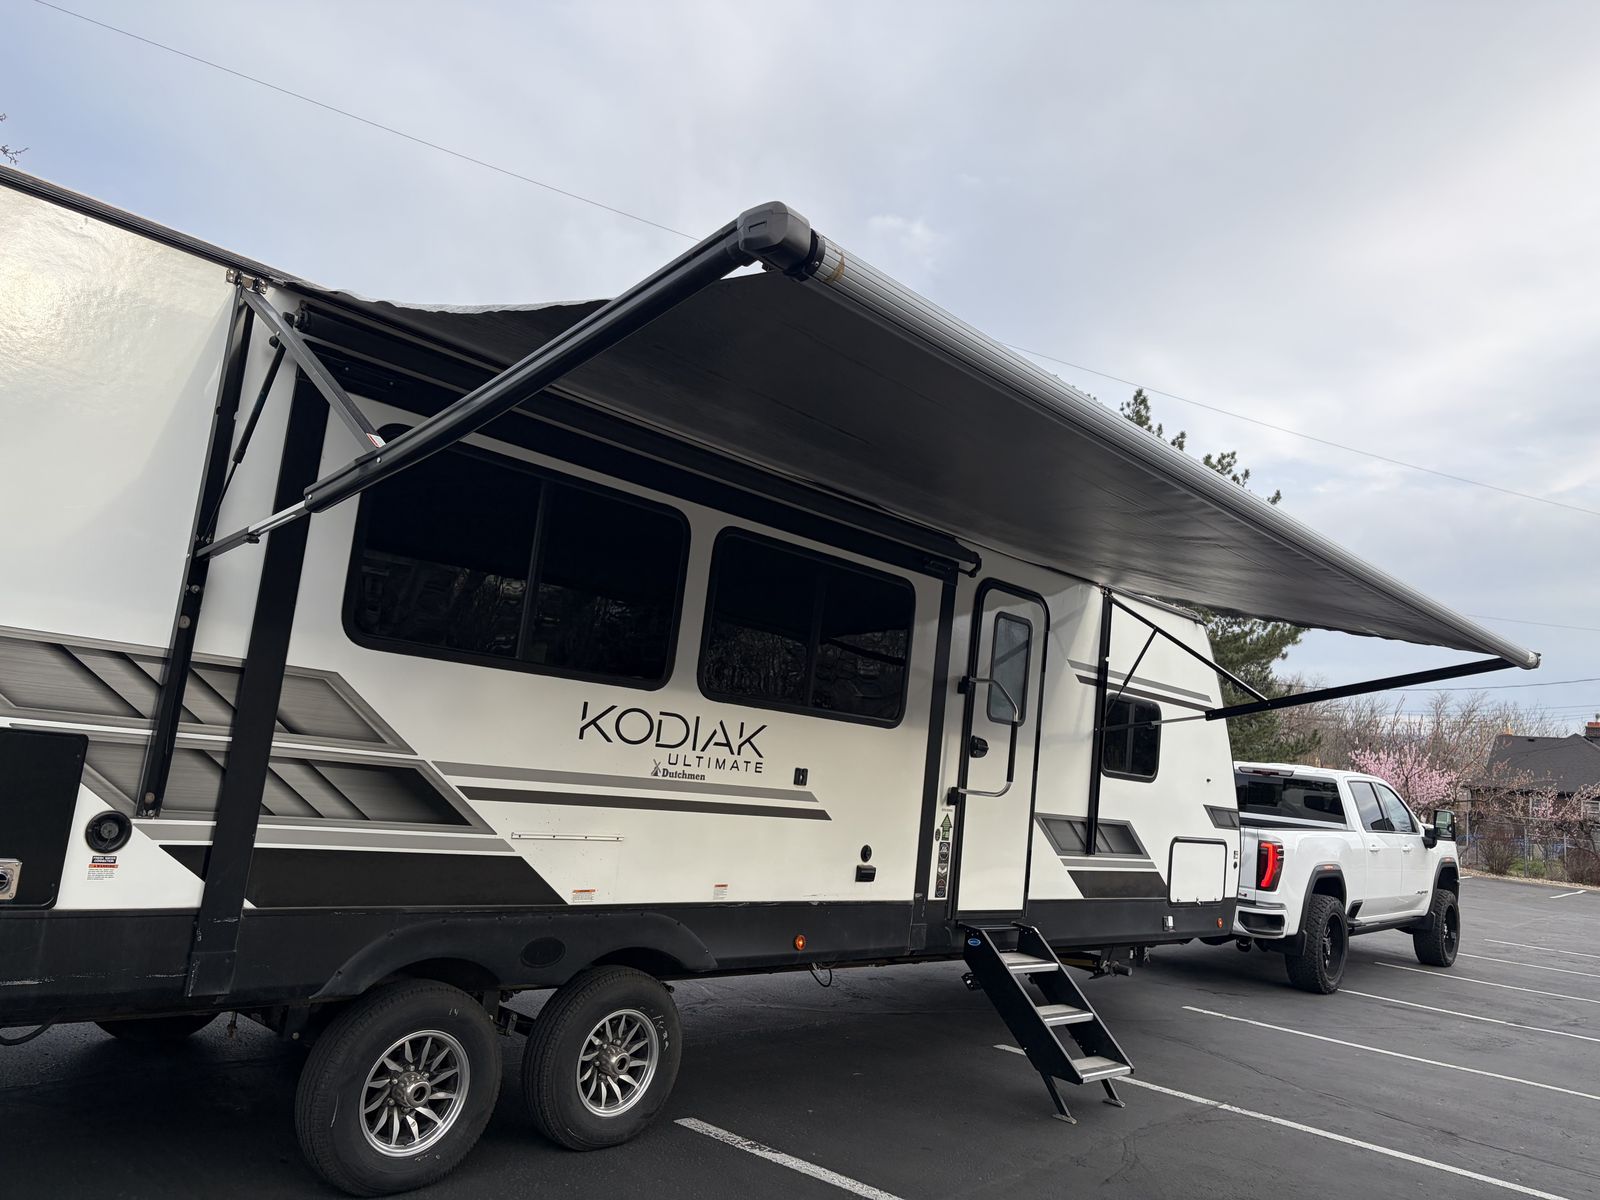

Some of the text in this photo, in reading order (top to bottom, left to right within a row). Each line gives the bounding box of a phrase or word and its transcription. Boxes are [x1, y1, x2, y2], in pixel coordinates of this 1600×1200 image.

[578, 701, 767, 758] KODIAK
[661, 767, 706, 781] Dutchmen
[667, 752, 763, 774] ULTIMATE
